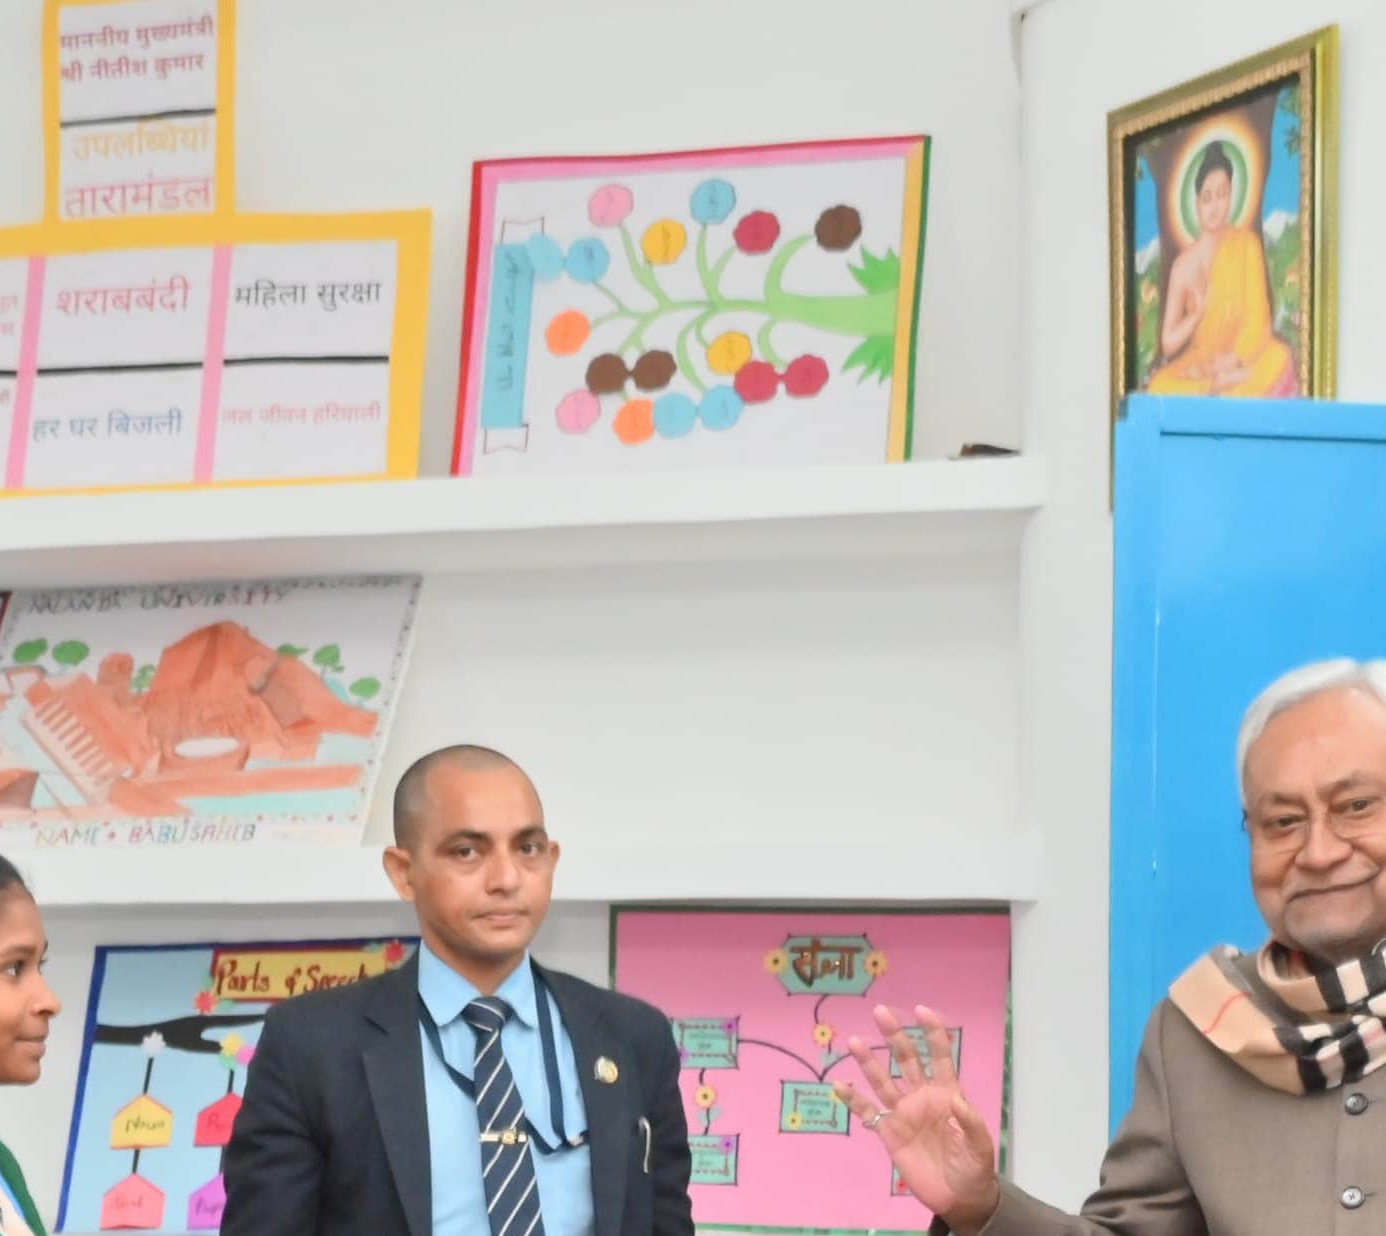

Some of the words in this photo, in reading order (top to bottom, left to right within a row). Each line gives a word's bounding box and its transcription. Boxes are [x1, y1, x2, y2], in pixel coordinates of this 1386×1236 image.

[60, 25, 129, 49] माननीय
[136, 14, 213, 48] मुख्यमंत्री
[60, 60, 82, 81] श्री
[90, 55, 147, 79] नीतीश
[155, 54, 204, 80] कुमार
[65, 172, 214, 217] तारामंडल
[56, 274, 191, 317] शराबबंदी
[234, 278, 306, 309] महिला
[317, 279, 383, 312] सुरक्षा
[32, 417, 61, 442] हर
[69, 416, 97, 438] घर
[107, 407, 183, 437] बिजली
[313, 400, 382, 425] हरियाली
[216, 959, 270, 995] Parts
